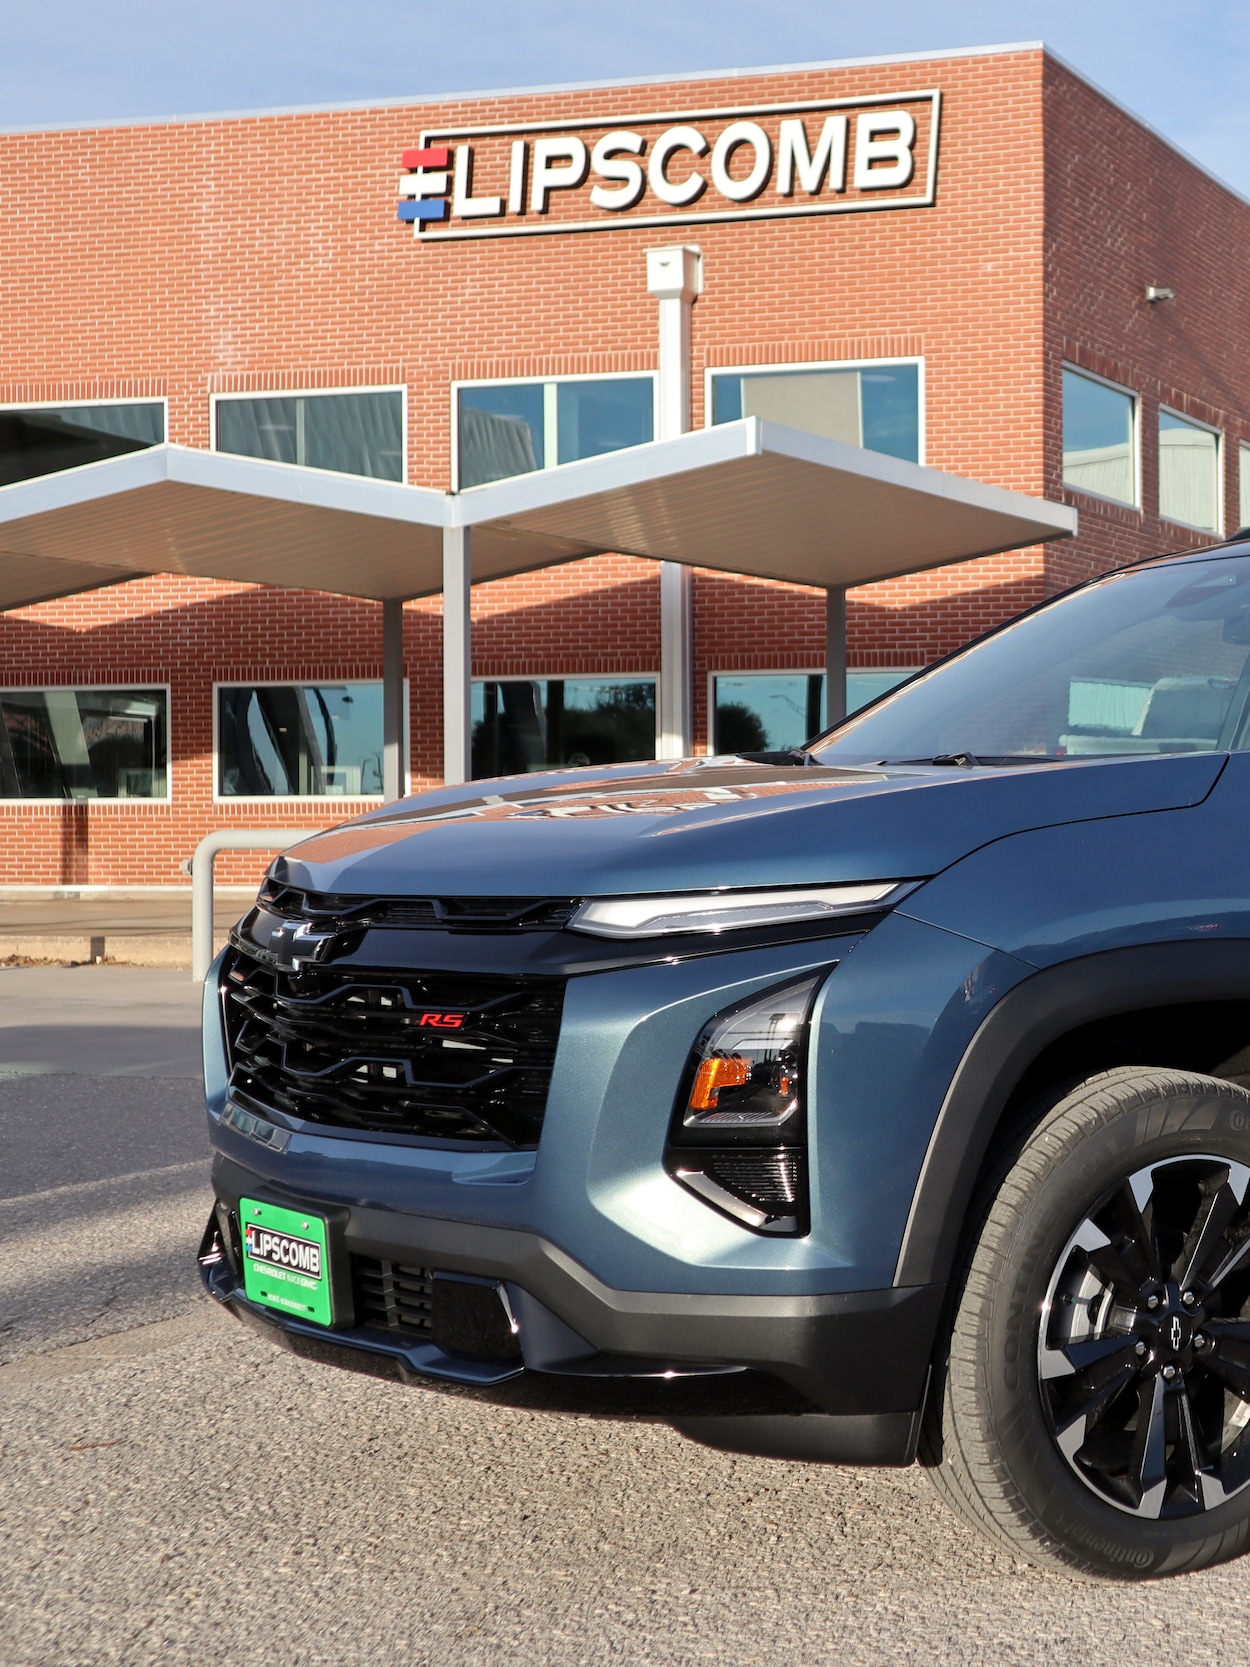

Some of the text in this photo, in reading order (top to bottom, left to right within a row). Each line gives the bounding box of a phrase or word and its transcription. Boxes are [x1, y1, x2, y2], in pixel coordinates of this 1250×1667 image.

[452, 109, 915, 218] LIPSCOMB
[419, 1013, 465, 1028] RS
[251, 1230, 320, 1273] LIPSCOMB
